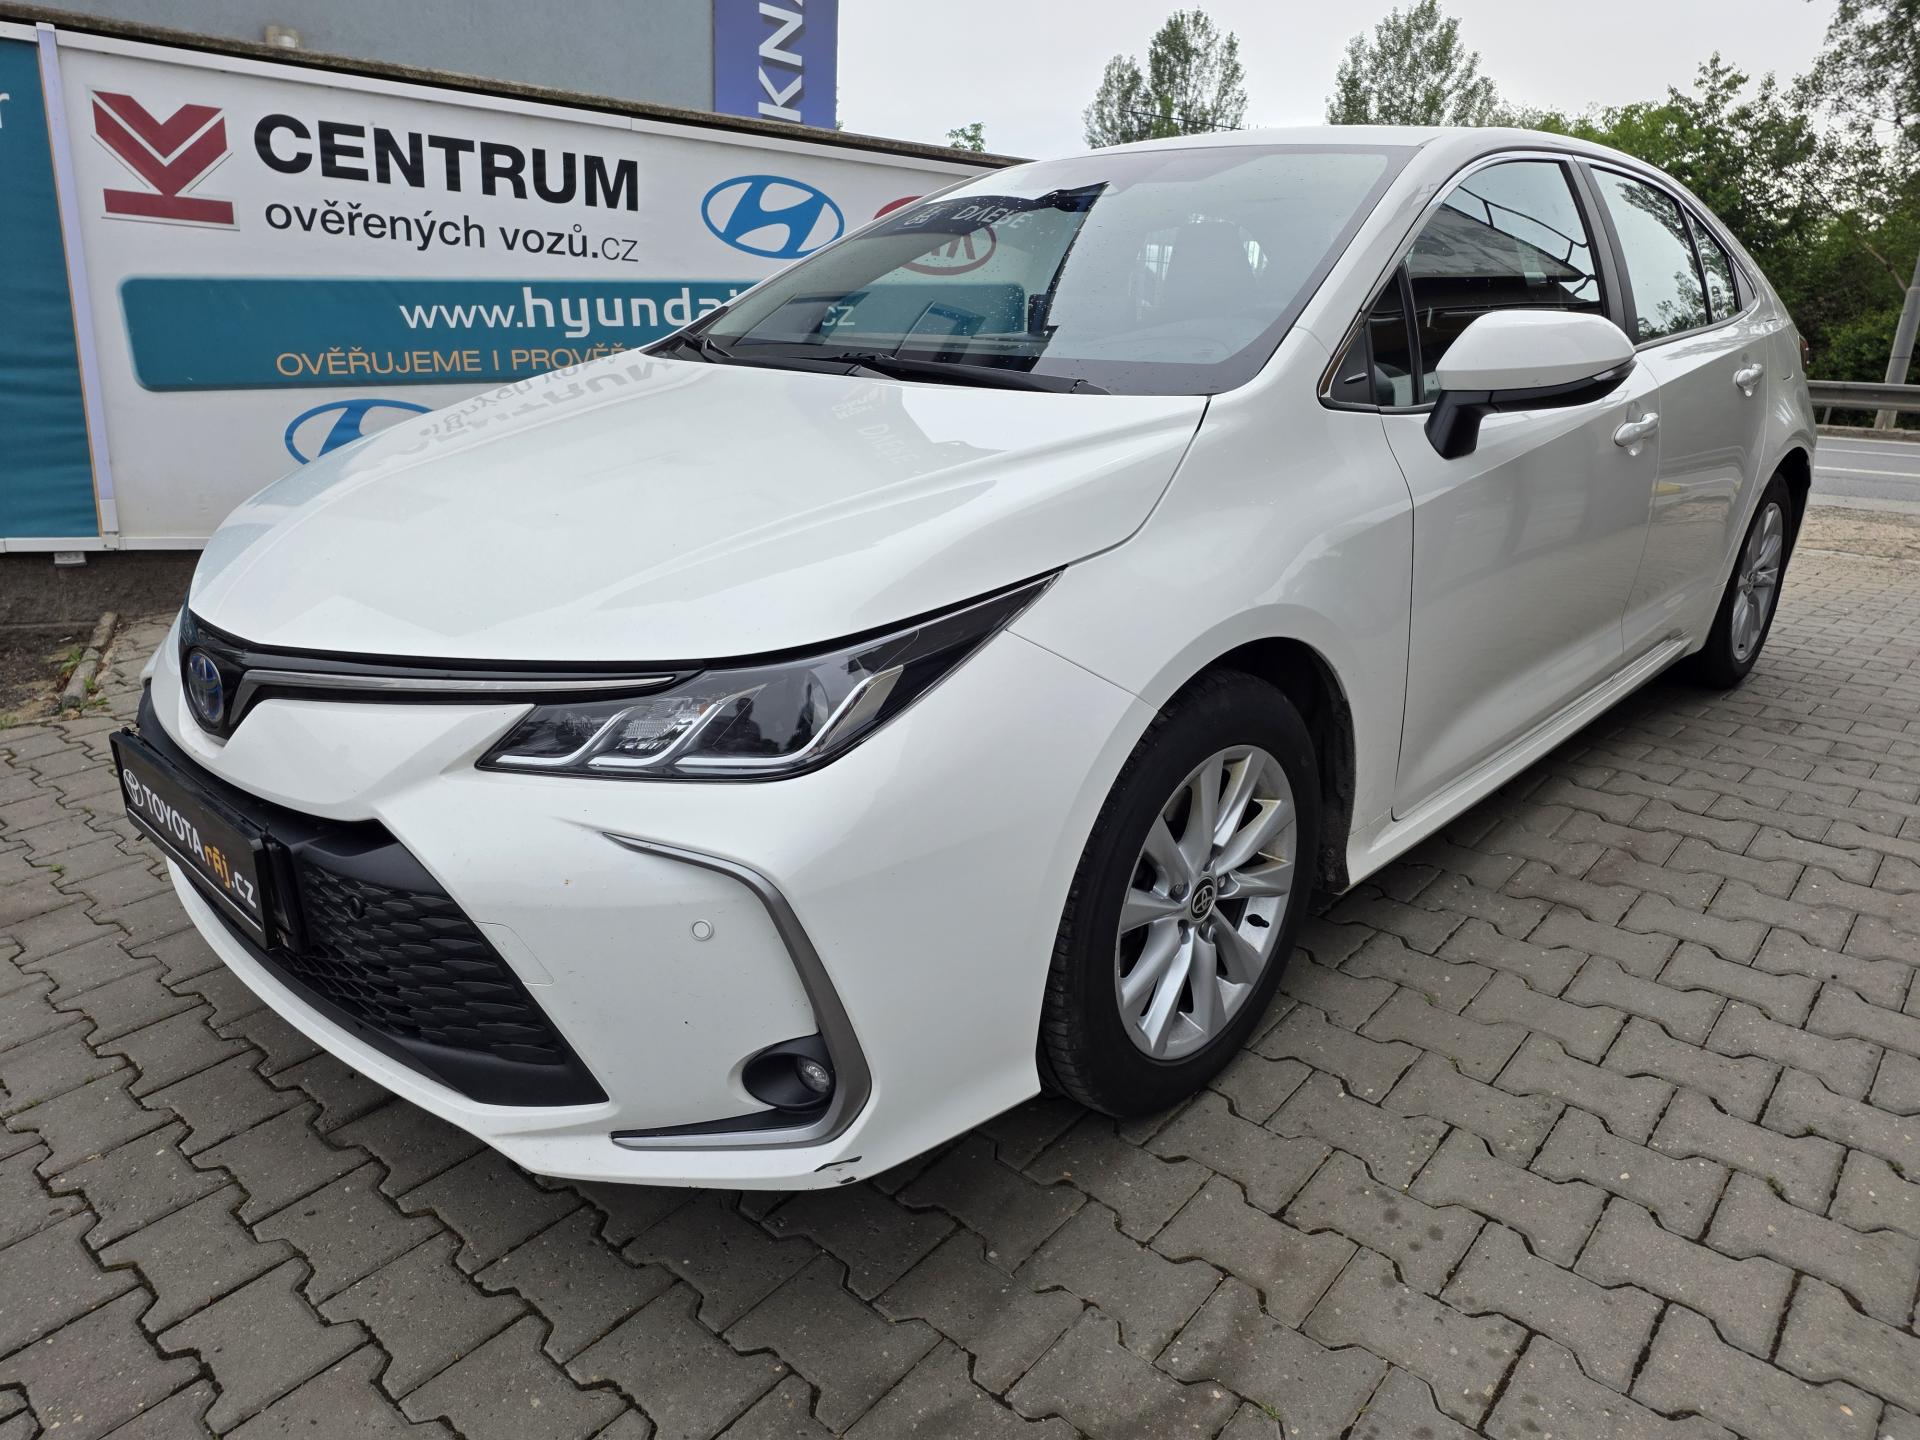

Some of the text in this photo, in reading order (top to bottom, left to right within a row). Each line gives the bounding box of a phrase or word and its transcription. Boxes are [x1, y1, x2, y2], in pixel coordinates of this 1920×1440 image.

[758, 0, 803, 122] KN
[254, 113, 639, 211] CENTRUM
[265, 199, 486, 251] ověřených
[400, 287, 737, 338] www.hyunda
[276, 346, 482, 376] OVĚŘUJEME
[492, 350, 499, 371] I
